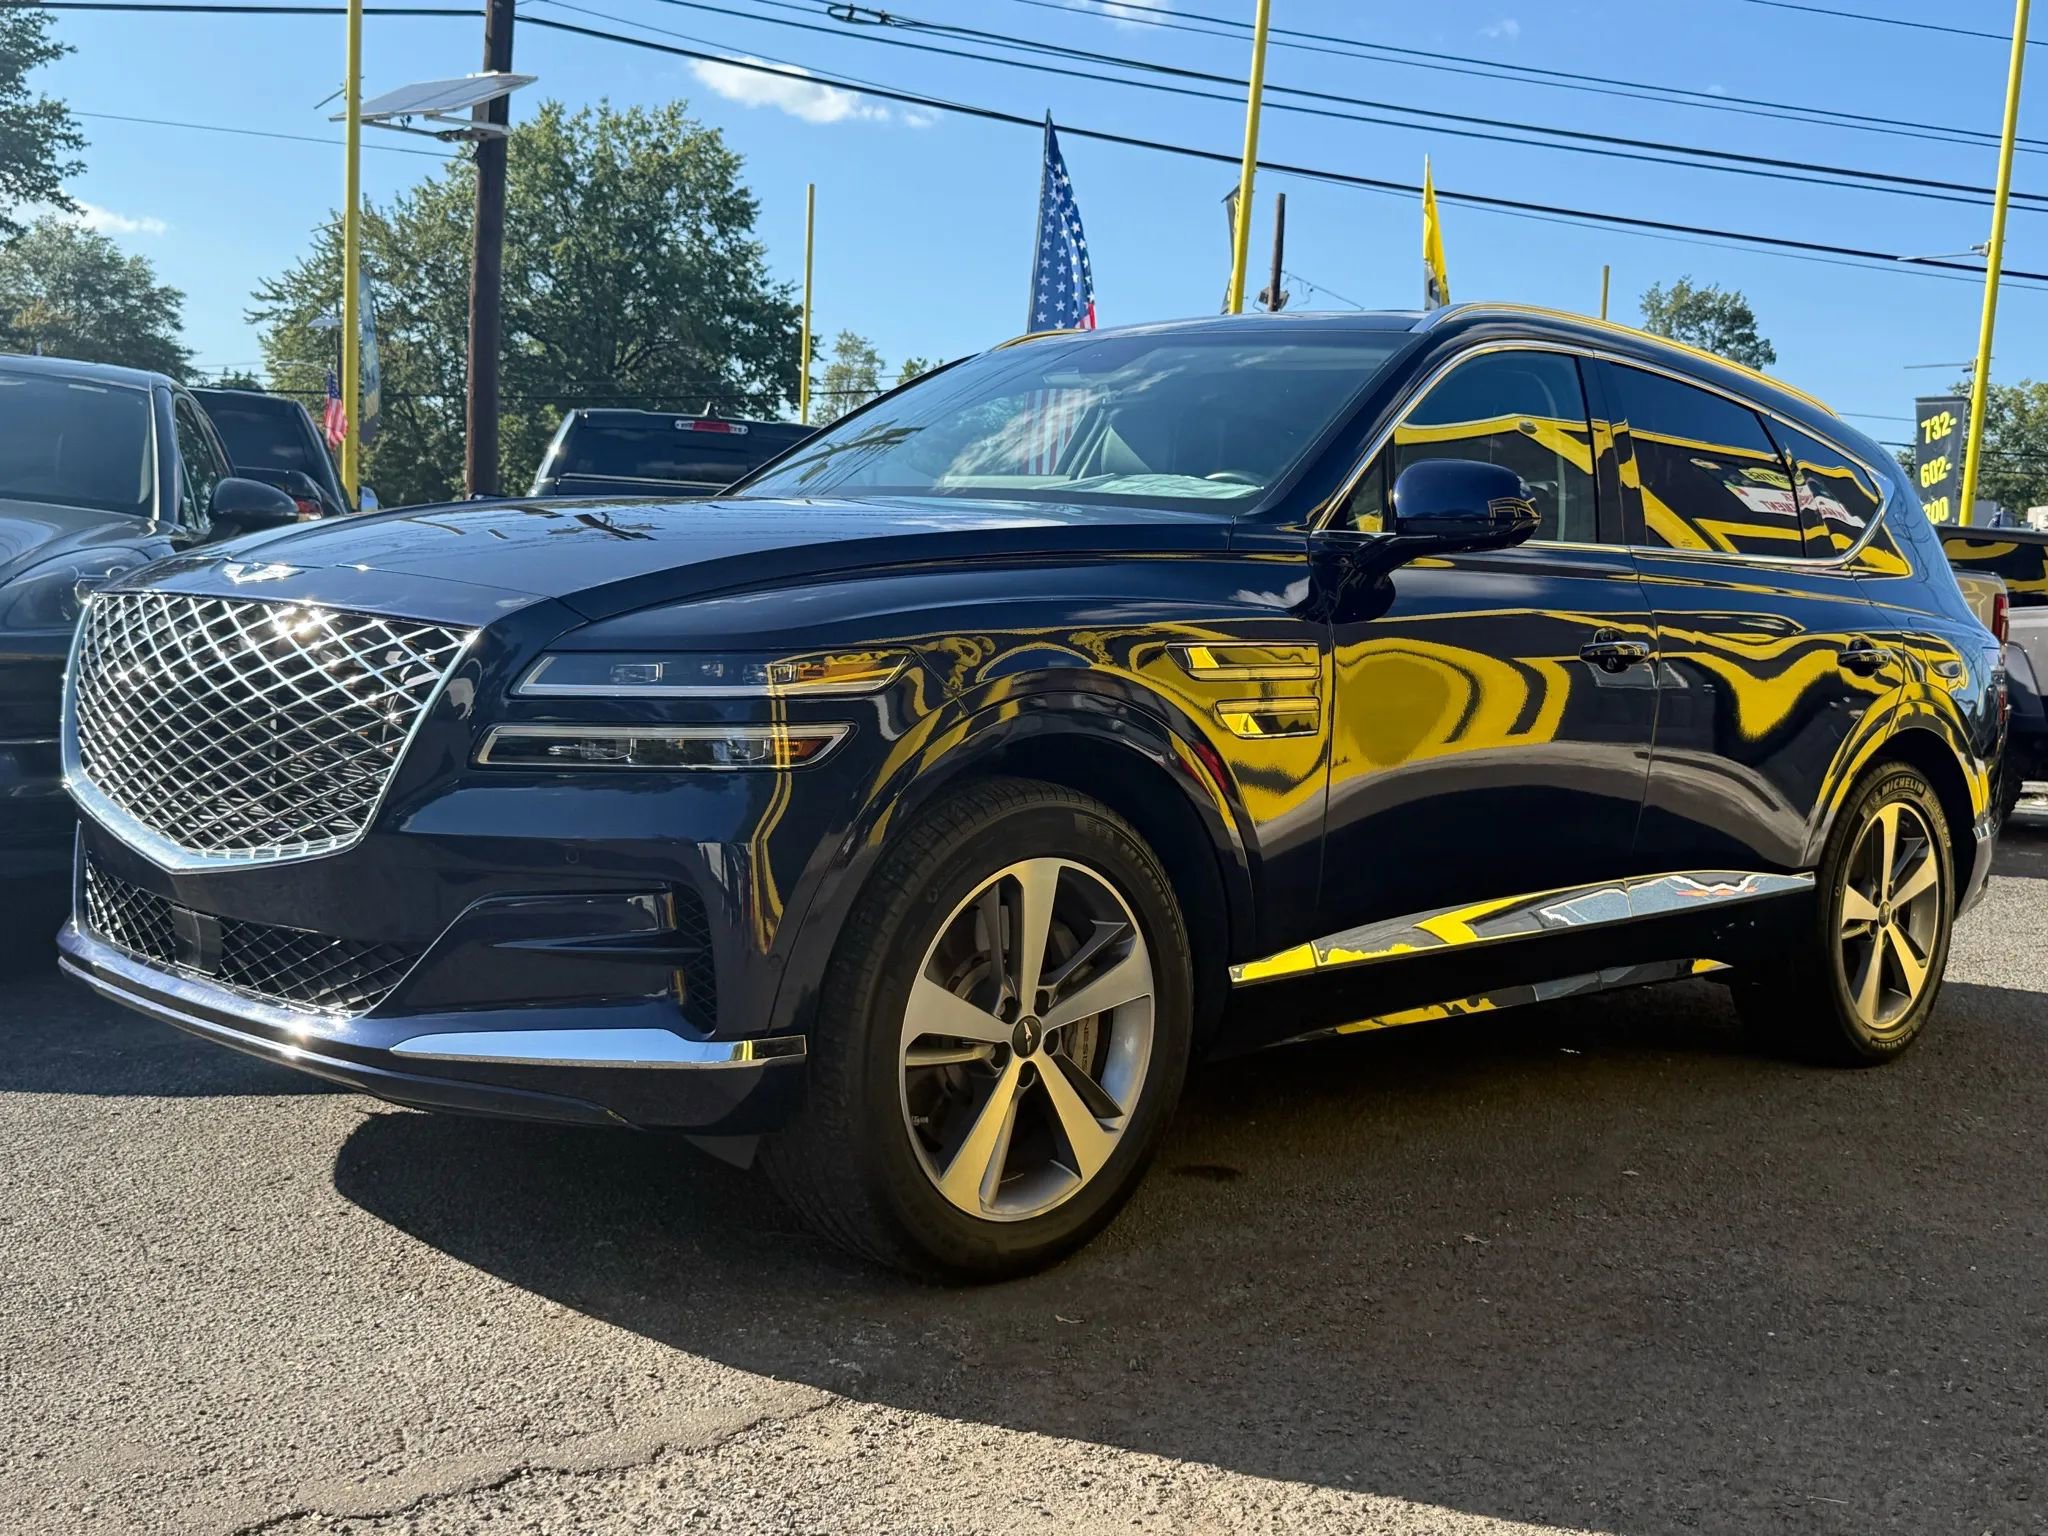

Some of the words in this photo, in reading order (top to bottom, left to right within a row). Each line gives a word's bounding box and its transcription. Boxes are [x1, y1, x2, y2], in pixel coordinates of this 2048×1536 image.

[1921, 411, 1957, 444] 732-
[1920, 456, 1952, 488] 602-
[1881, 776, 1926, 796] MICHELIN
